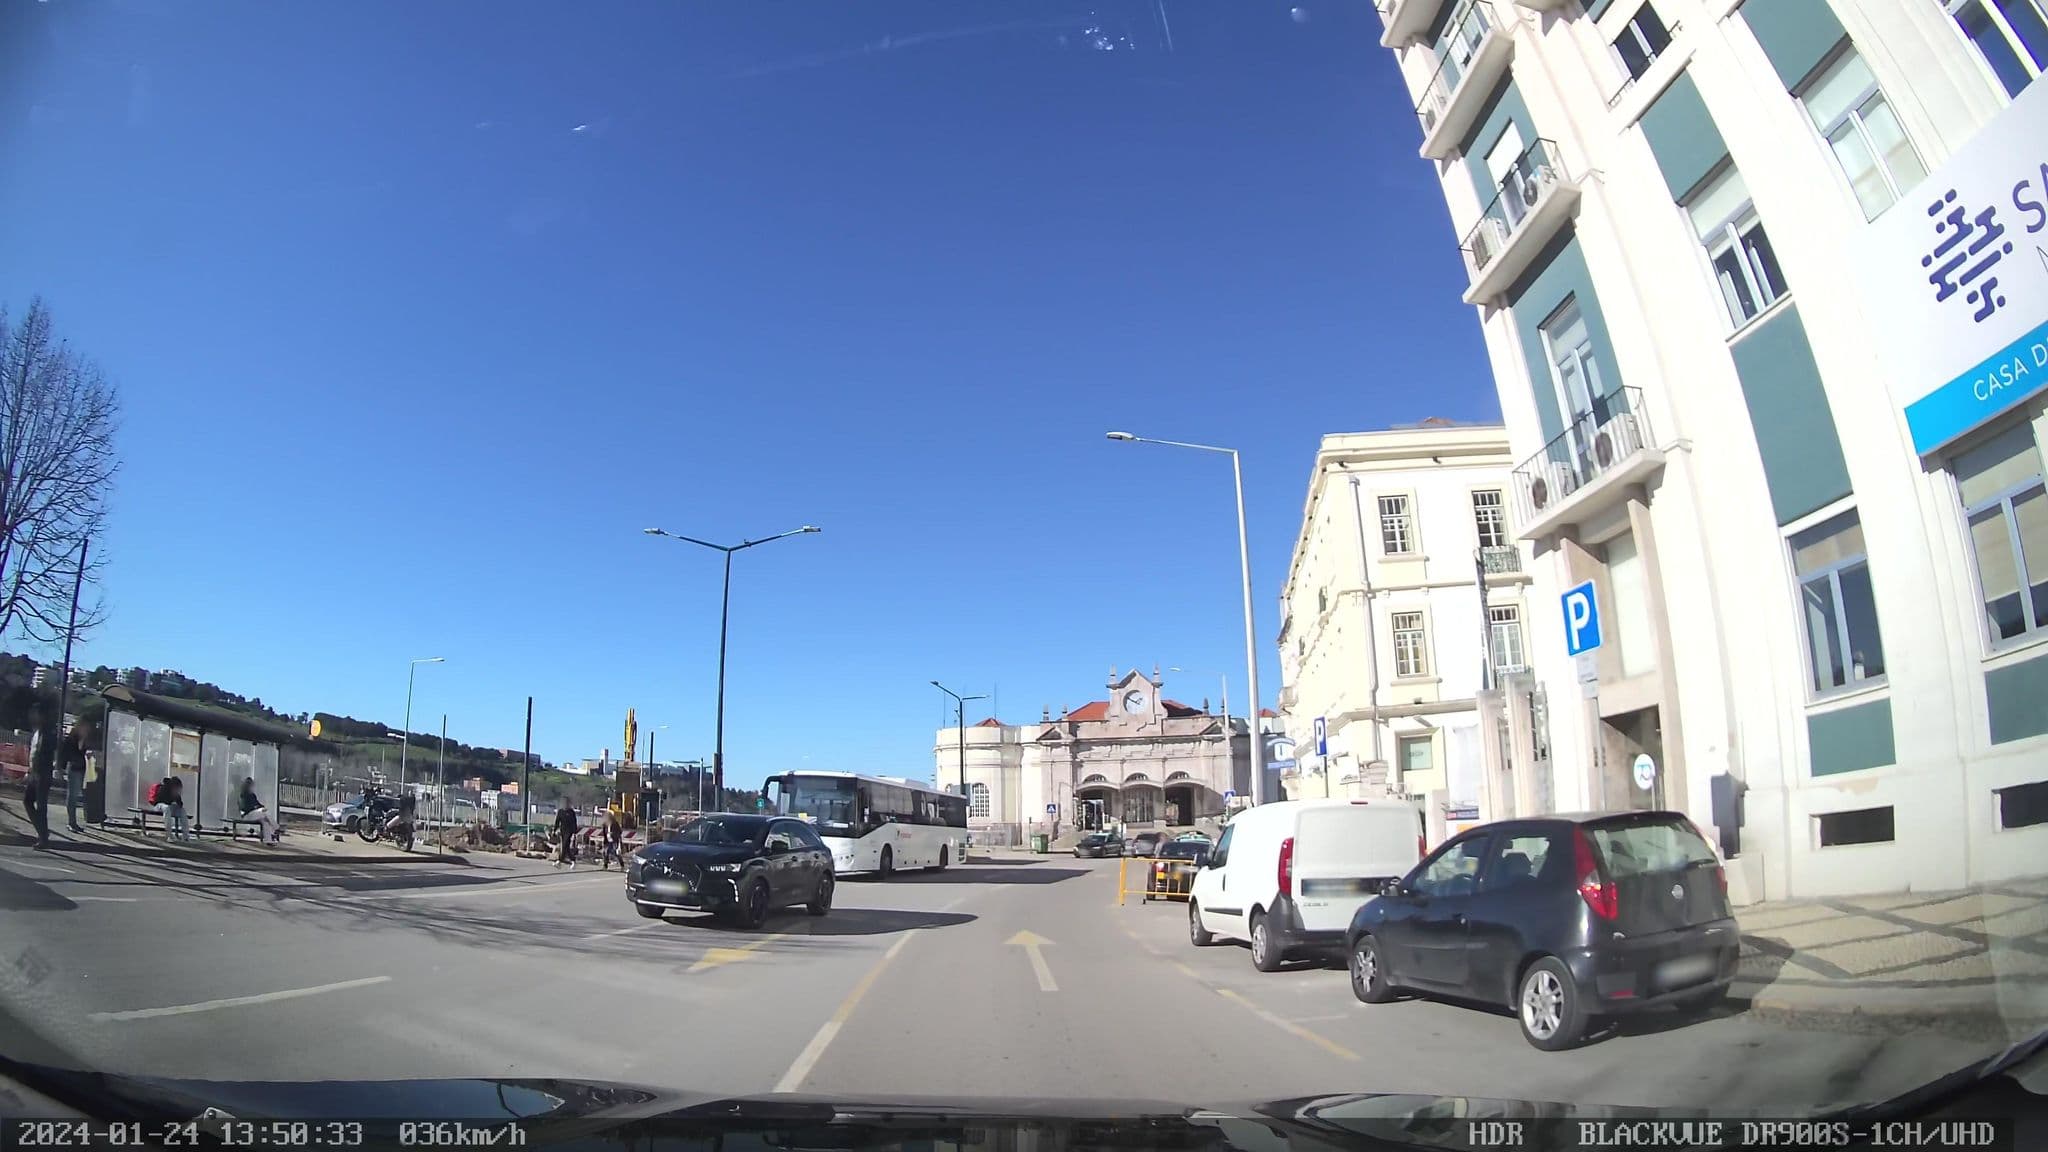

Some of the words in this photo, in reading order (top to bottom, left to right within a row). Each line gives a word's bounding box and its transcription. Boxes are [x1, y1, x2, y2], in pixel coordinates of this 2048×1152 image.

[1974, 356, 2029, 401] CASA
[2031, 337, 2048, 368] D
[1566, 592, 1590, 650] P
[1315, 720, 1325, 754] P
